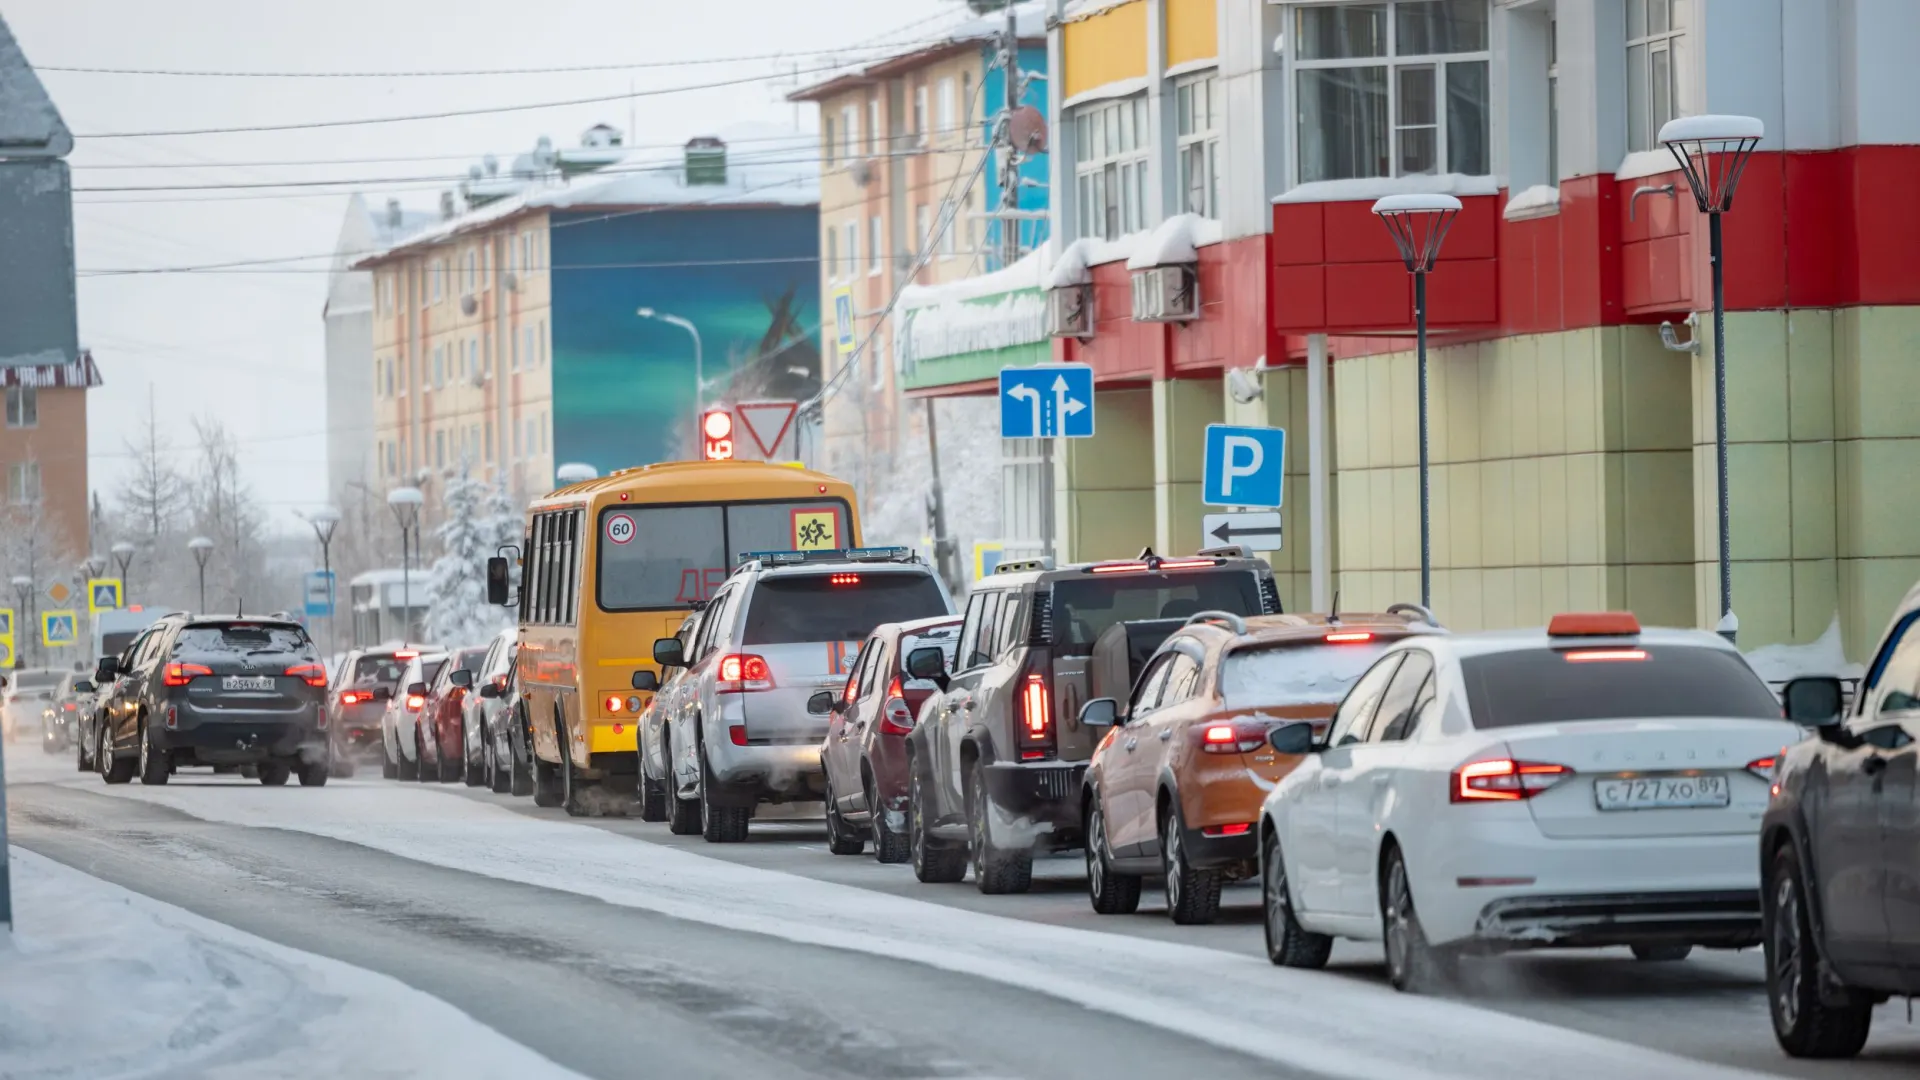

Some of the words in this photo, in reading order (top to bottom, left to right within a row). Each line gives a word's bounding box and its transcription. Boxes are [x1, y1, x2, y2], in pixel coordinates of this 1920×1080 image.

[1221, 435, 1264, 497] P
[612, 522, 630, 536] 60
[675, 568, 737, 602] ДЕ
